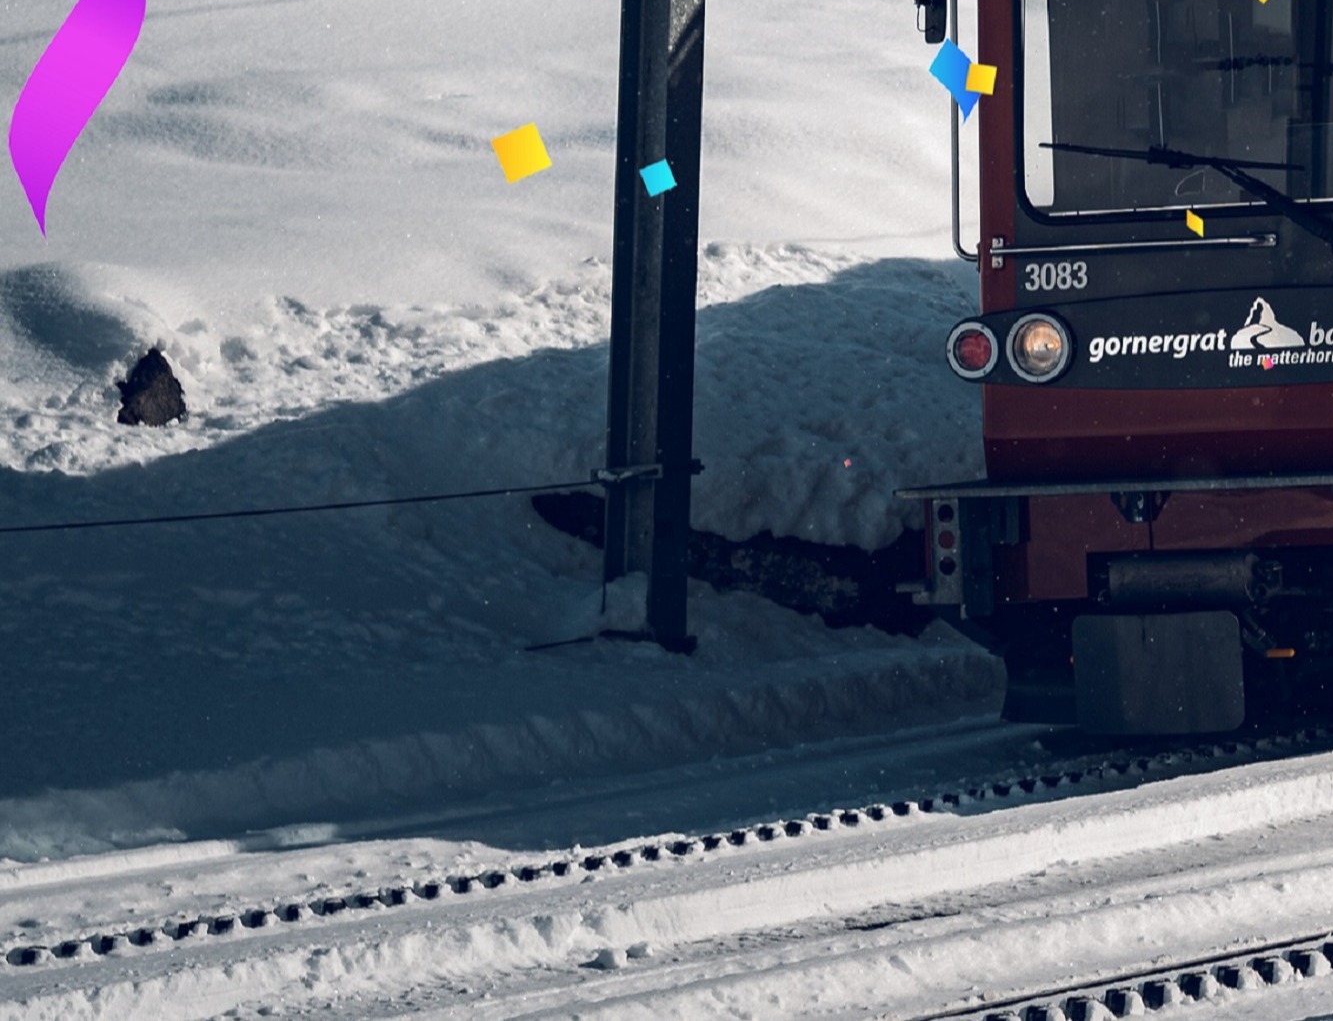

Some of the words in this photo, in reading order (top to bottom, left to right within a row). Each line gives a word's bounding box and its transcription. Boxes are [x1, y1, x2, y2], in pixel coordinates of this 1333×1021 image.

[1025, 261, 1088, 291] 3083
[1089, 328, 1227, 363] gornergrat
[1228, 350, 1252, 368] the
